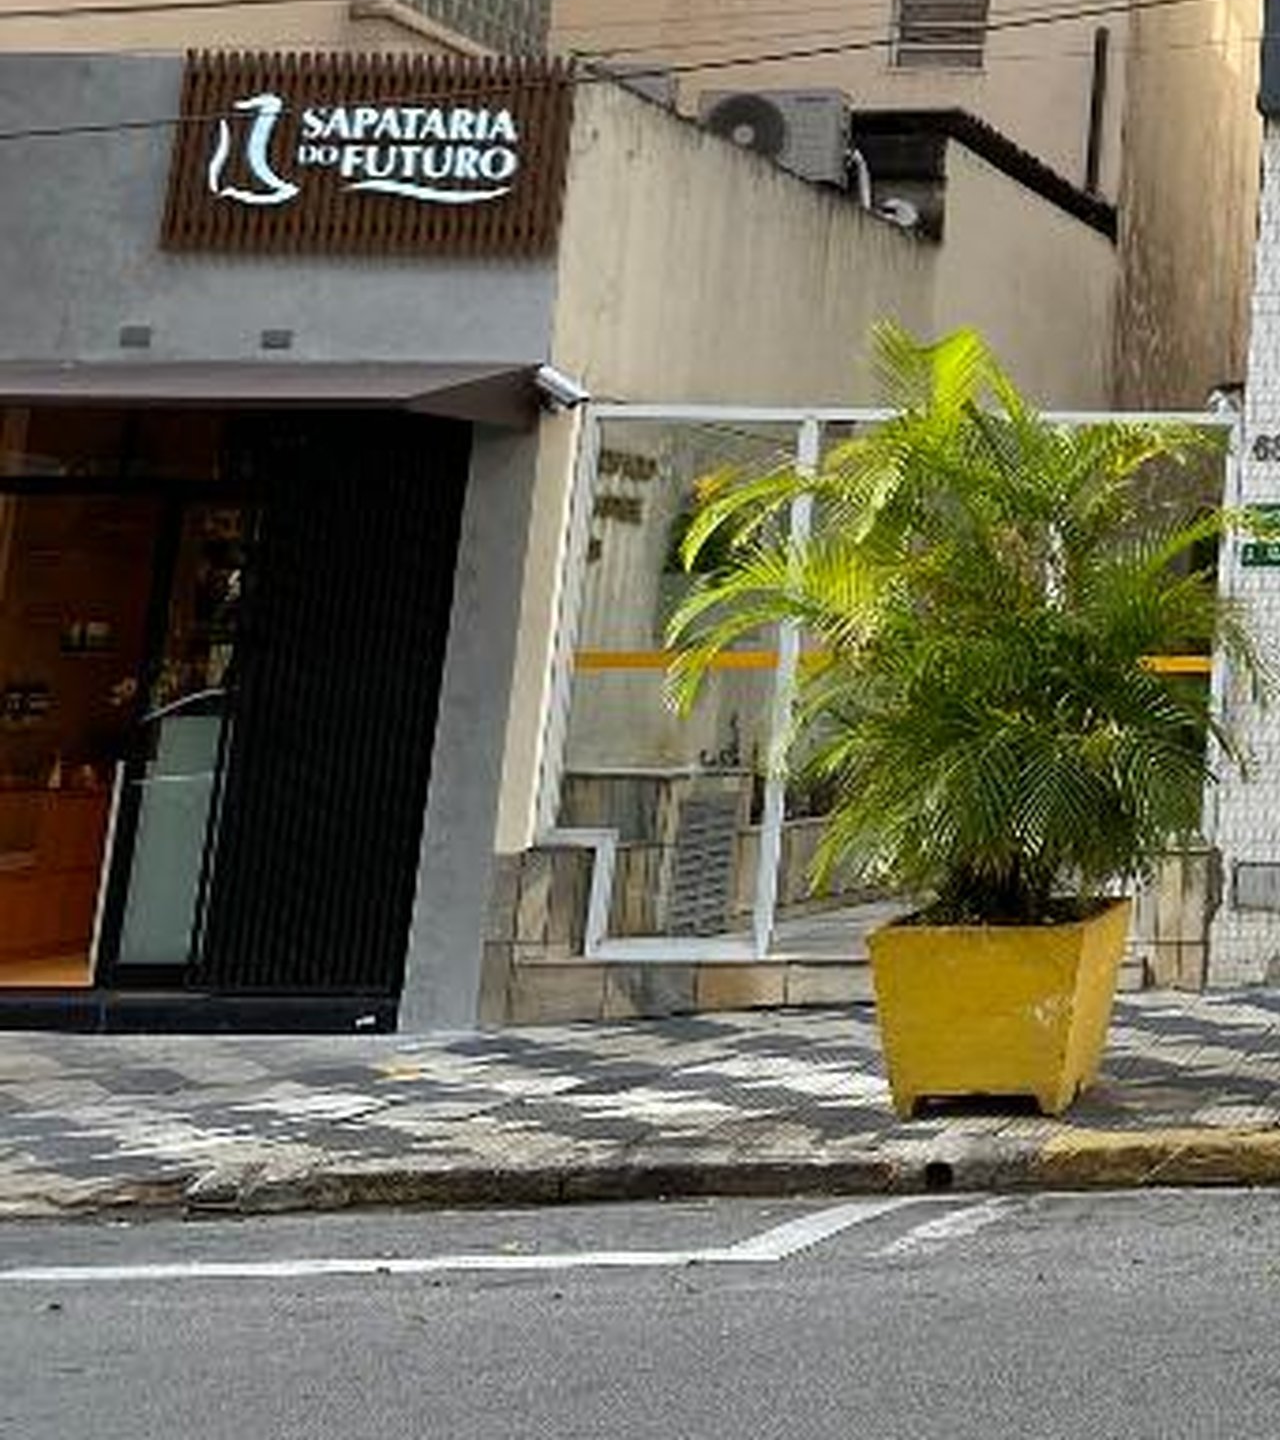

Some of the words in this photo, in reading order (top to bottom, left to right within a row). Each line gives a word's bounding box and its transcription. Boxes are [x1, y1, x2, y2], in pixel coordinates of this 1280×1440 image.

[302, 107, 518, 142] SAPATARIA
[299, 145, 338, 165] DO
[340, 144, 517, 179] FUTURO
